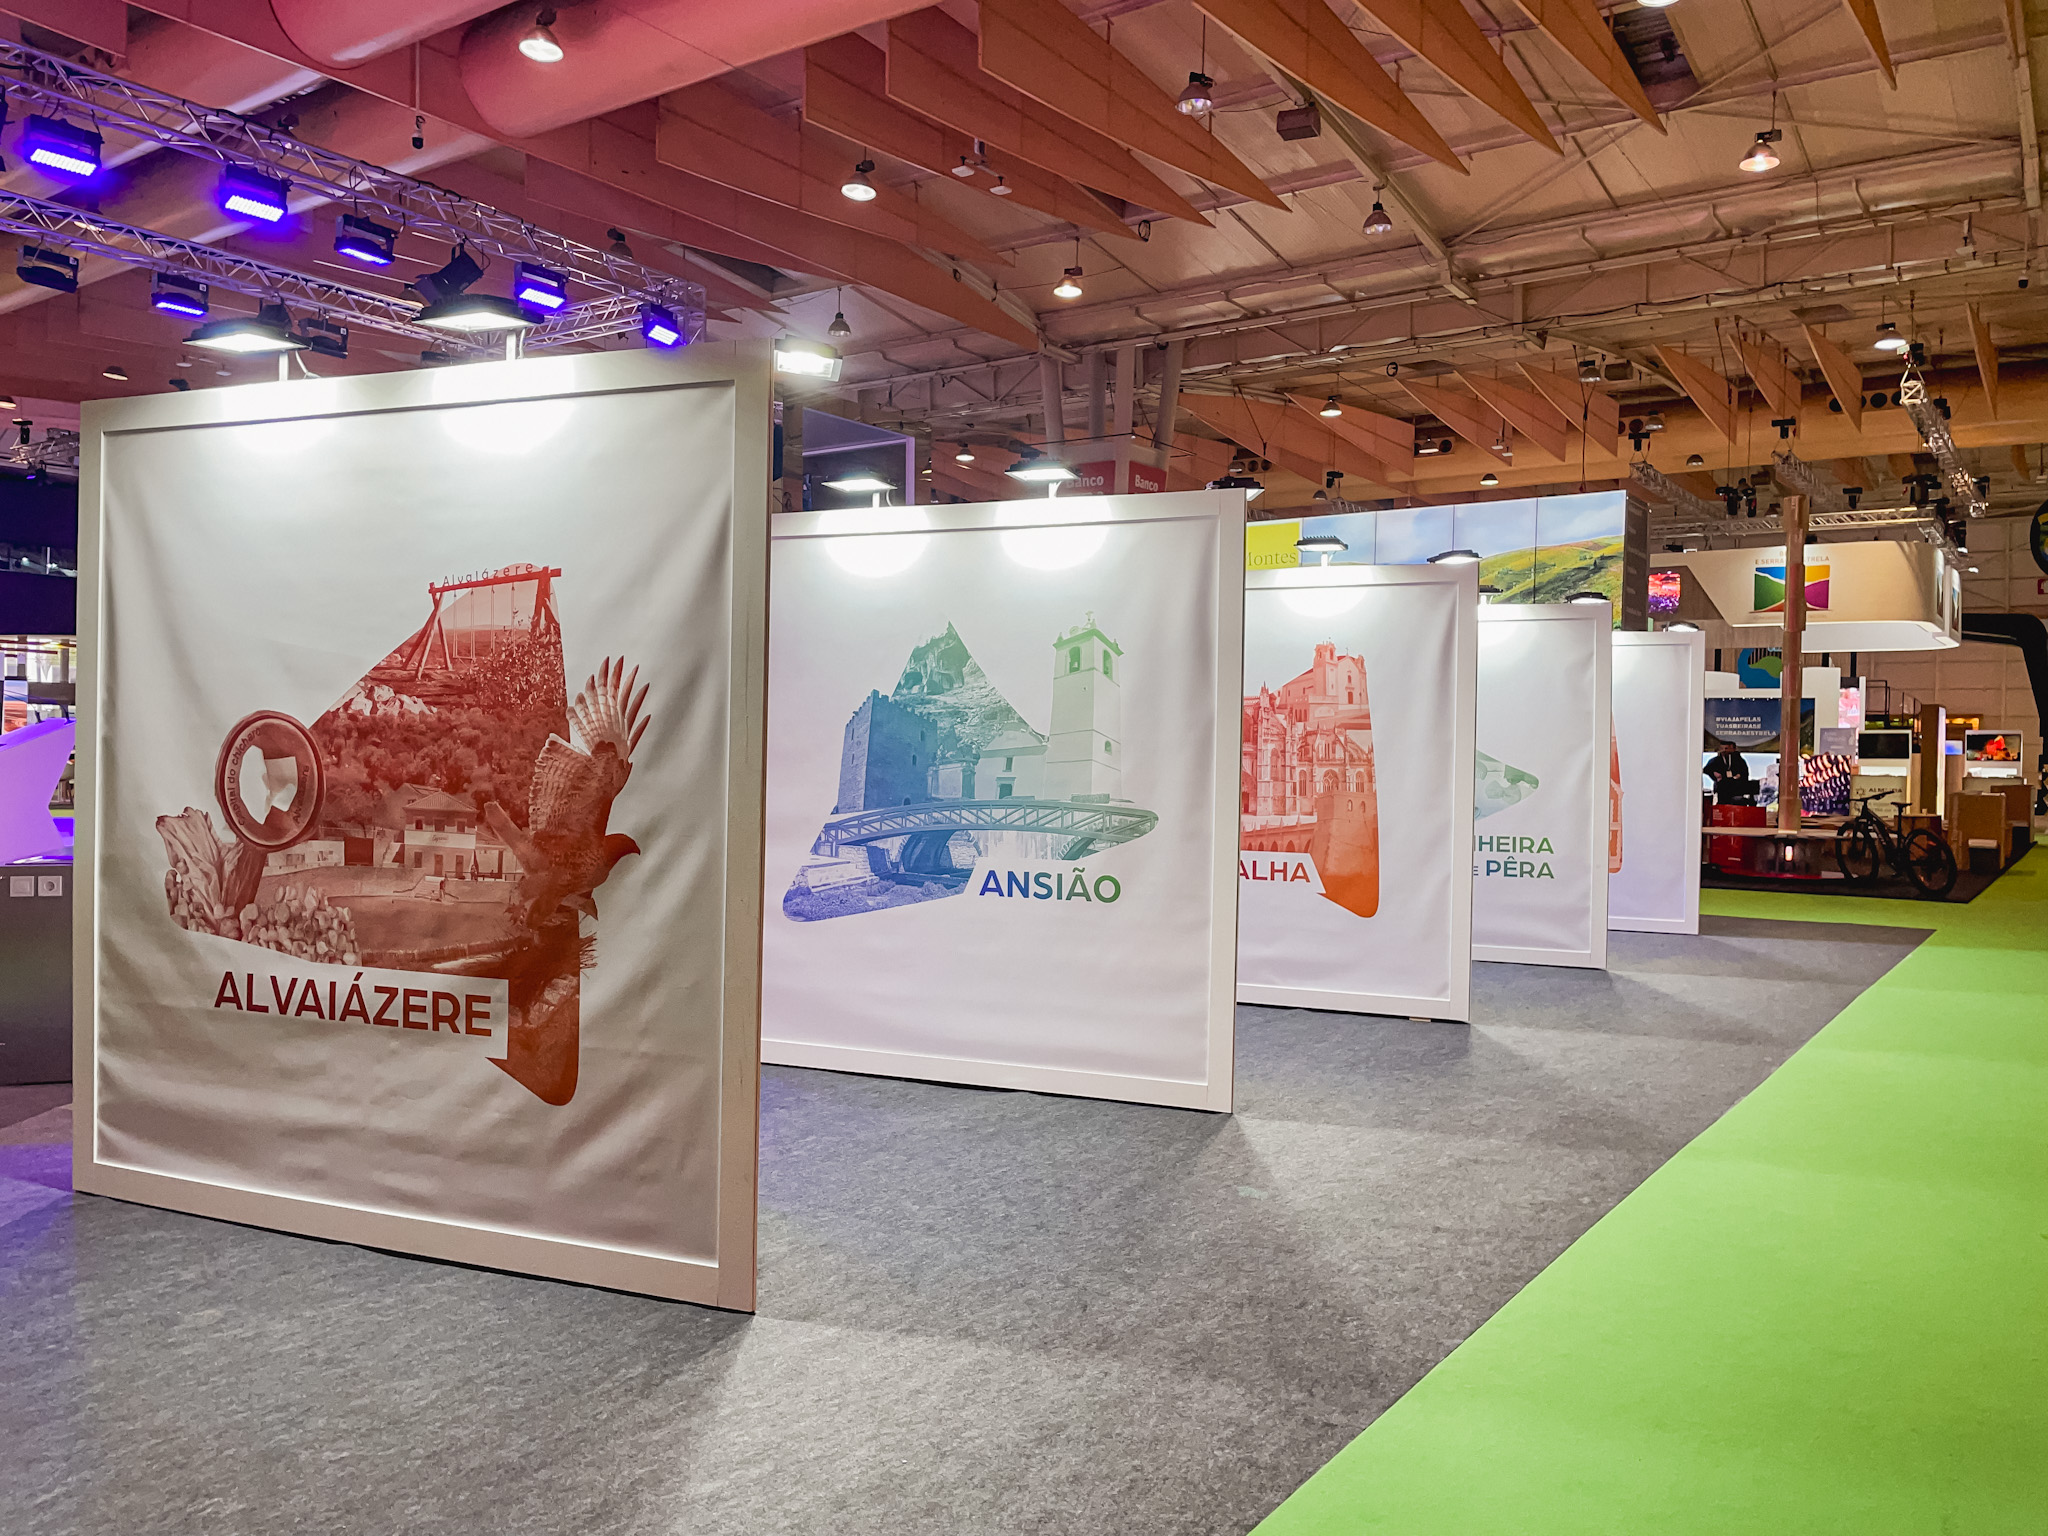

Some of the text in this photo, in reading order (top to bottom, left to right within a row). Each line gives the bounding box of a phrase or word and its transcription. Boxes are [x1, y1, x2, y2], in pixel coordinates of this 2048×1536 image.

[1135, 474, 1159, 492] Banco
[227, 769, 236, 783] do
[1474, 835, 1554, 854] HEIRA
[1486, 856, 1555, 879] PÊRA
[979, 867, 1121, 903] ANSIÃO
[214, 971, 492, 1037] ALVAIÁZERE
